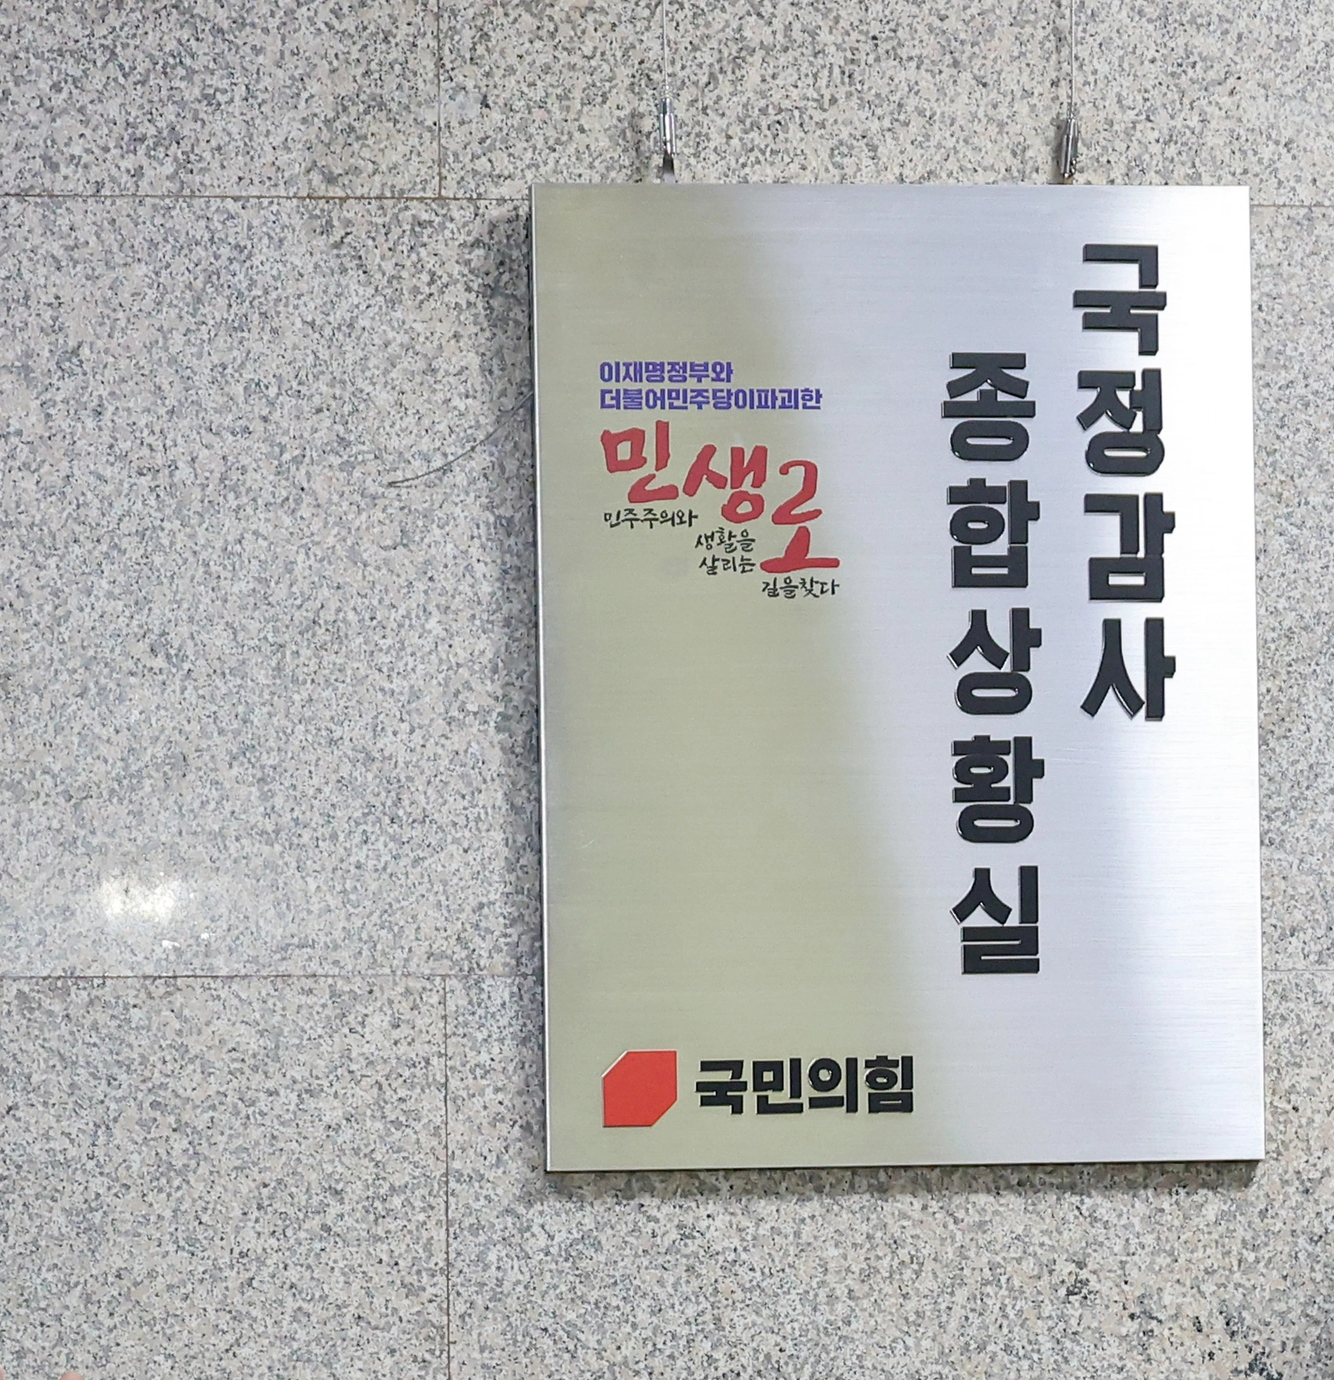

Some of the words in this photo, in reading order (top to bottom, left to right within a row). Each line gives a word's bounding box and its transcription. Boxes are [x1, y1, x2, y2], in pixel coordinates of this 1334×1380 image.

[599, 361, 734, 383] 이재명정부와
[1073, 243, 1175, 721] 국정감사
[604, 507, 698, 529] 민주주의와
[695, 527, 756, 553] 생활을
[699, 555, 756, 575] 살리는
[941, 351, 1045, 974] 종합상황실
[694, 1056, 915, 1116] 국민의힘
